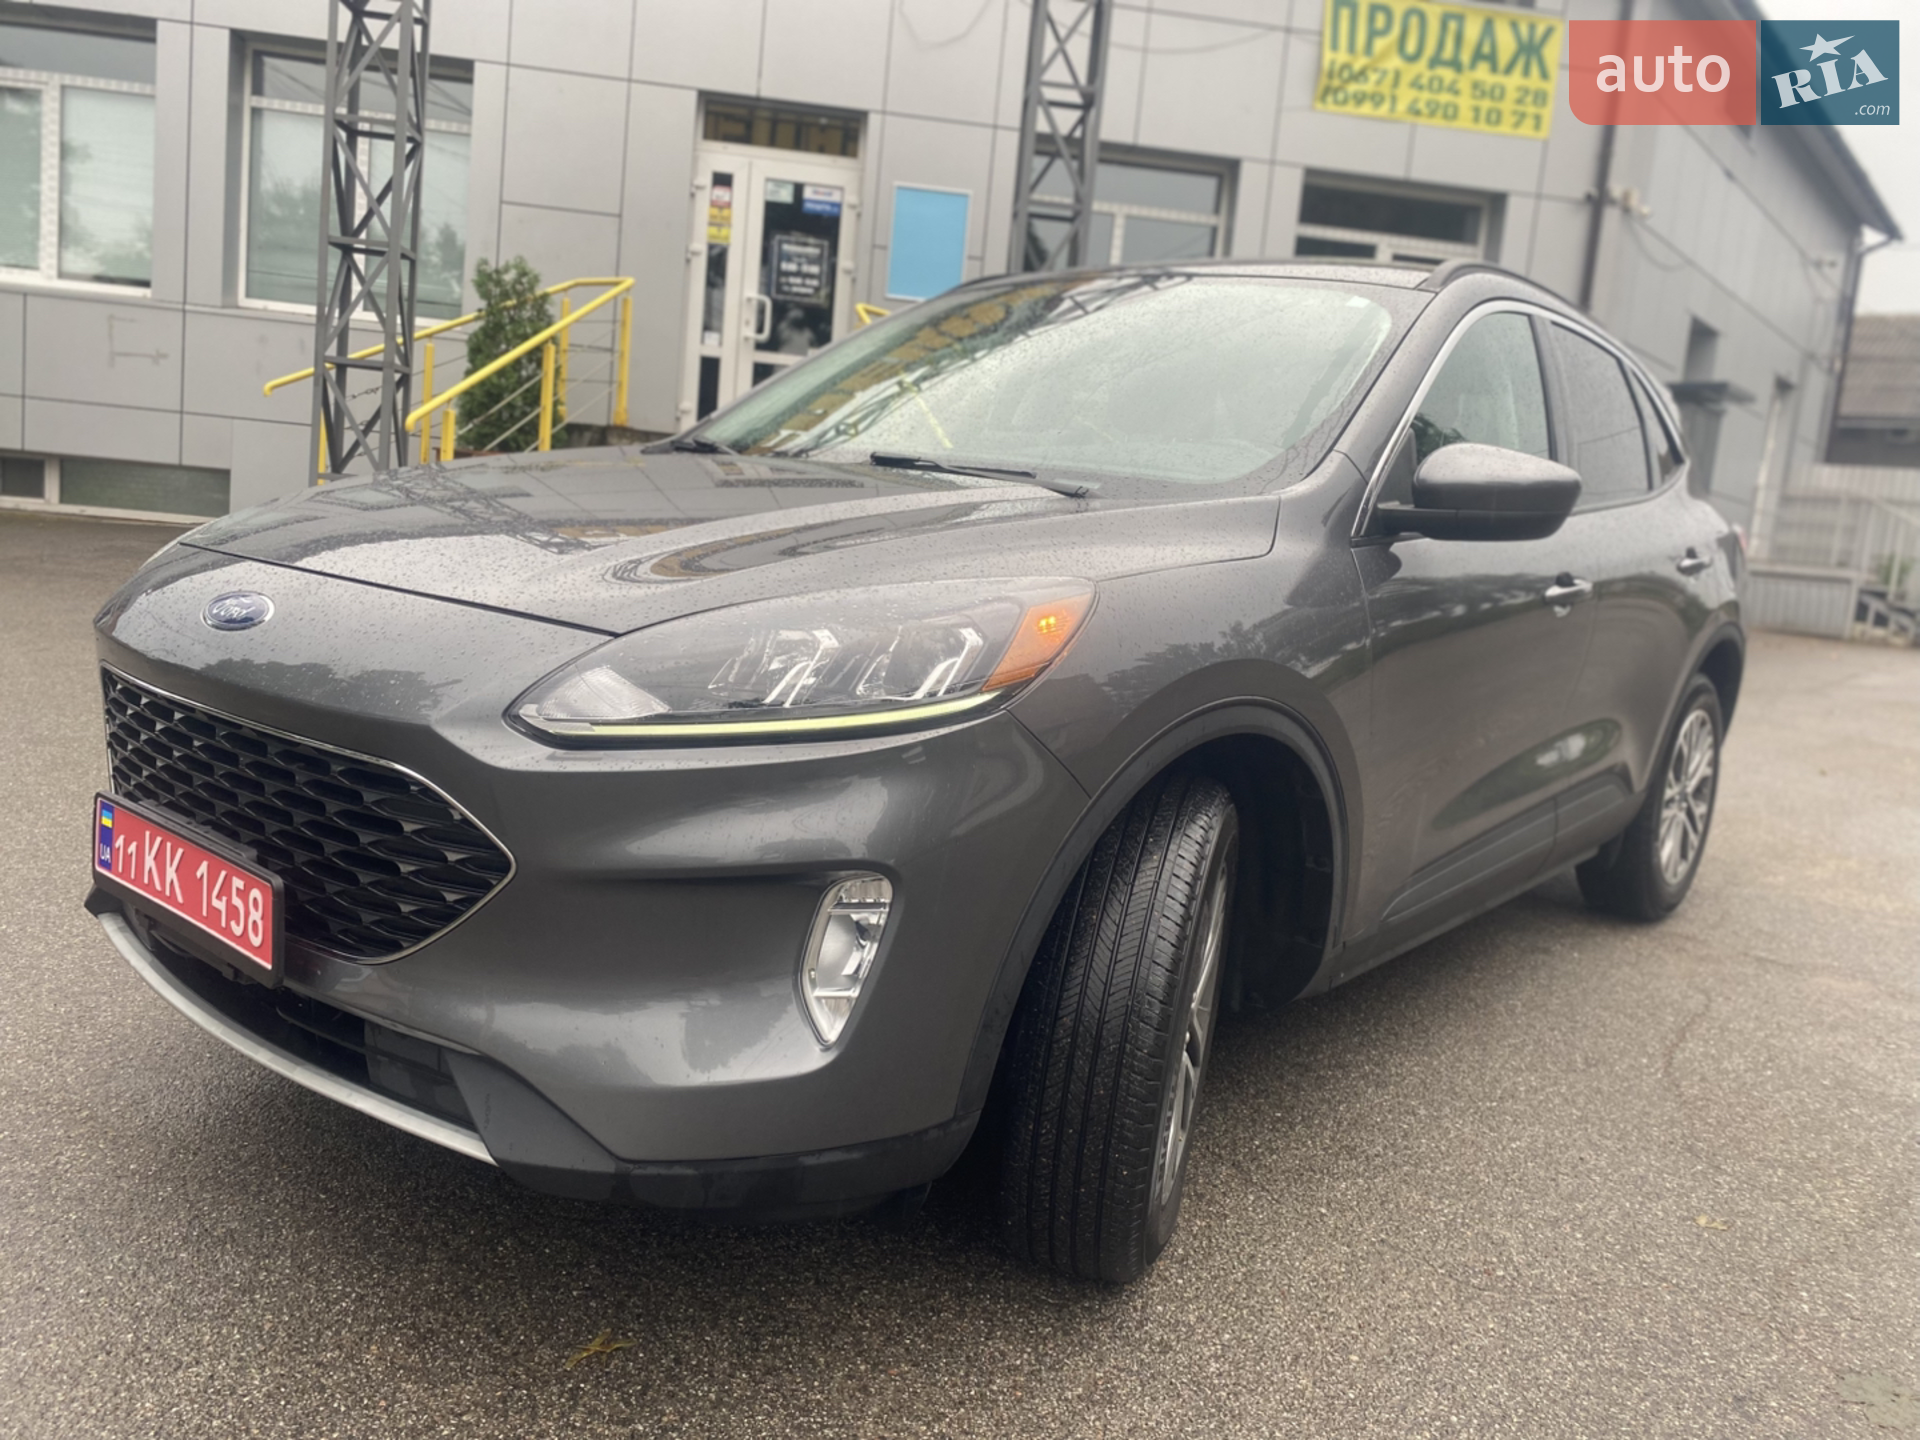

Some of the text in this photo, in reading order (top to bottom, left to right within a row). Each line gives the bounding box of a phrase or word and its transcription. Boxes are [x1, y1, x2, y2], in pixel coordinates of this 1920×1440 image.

[1329, 0, 1556, 81] ПРОДАЖ
[1409, 72, 1461, 97] 404
[1470, 79, 1506, 103] 50
[1406, 96, 1459, 122] 490
[1469, 104, 1504, 128] 10
[1509, 109, 1543, 133] 71
[100, 841, 112, 864] UA
[195, 859, 264, 948] 1458
